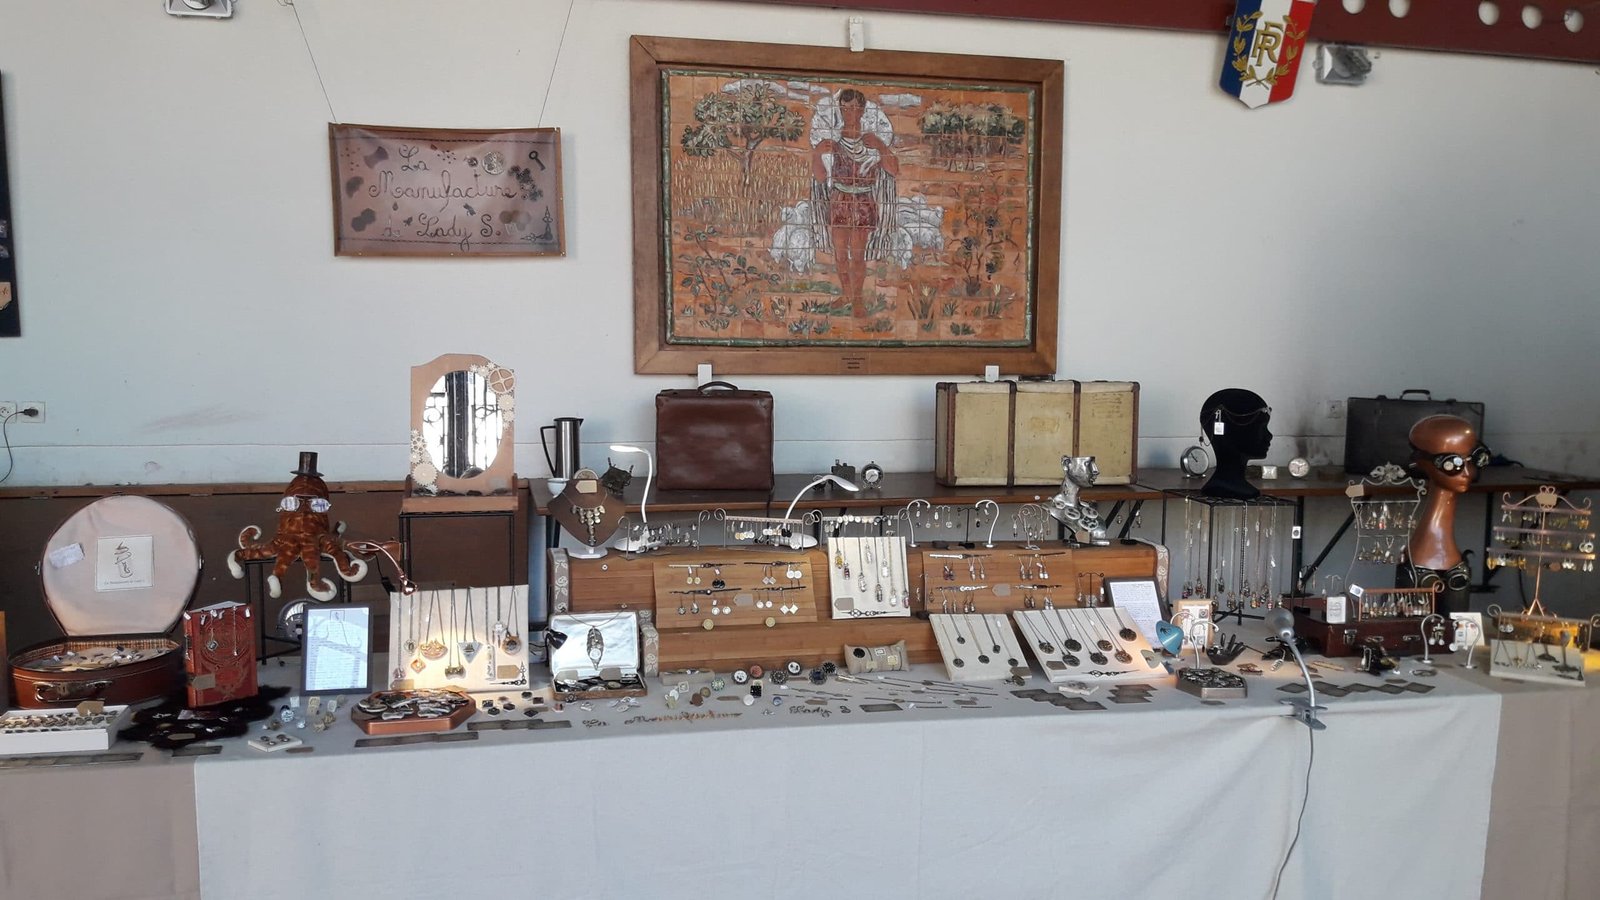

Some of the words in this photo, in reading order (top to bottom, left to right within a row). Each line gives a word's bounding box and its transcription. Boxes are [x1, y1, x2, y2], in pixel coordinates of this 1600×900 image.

[398, 144, 430, 171] La
[369, 170, 518, 213] Manufacture
[416, 212, 472, 252] Lady
